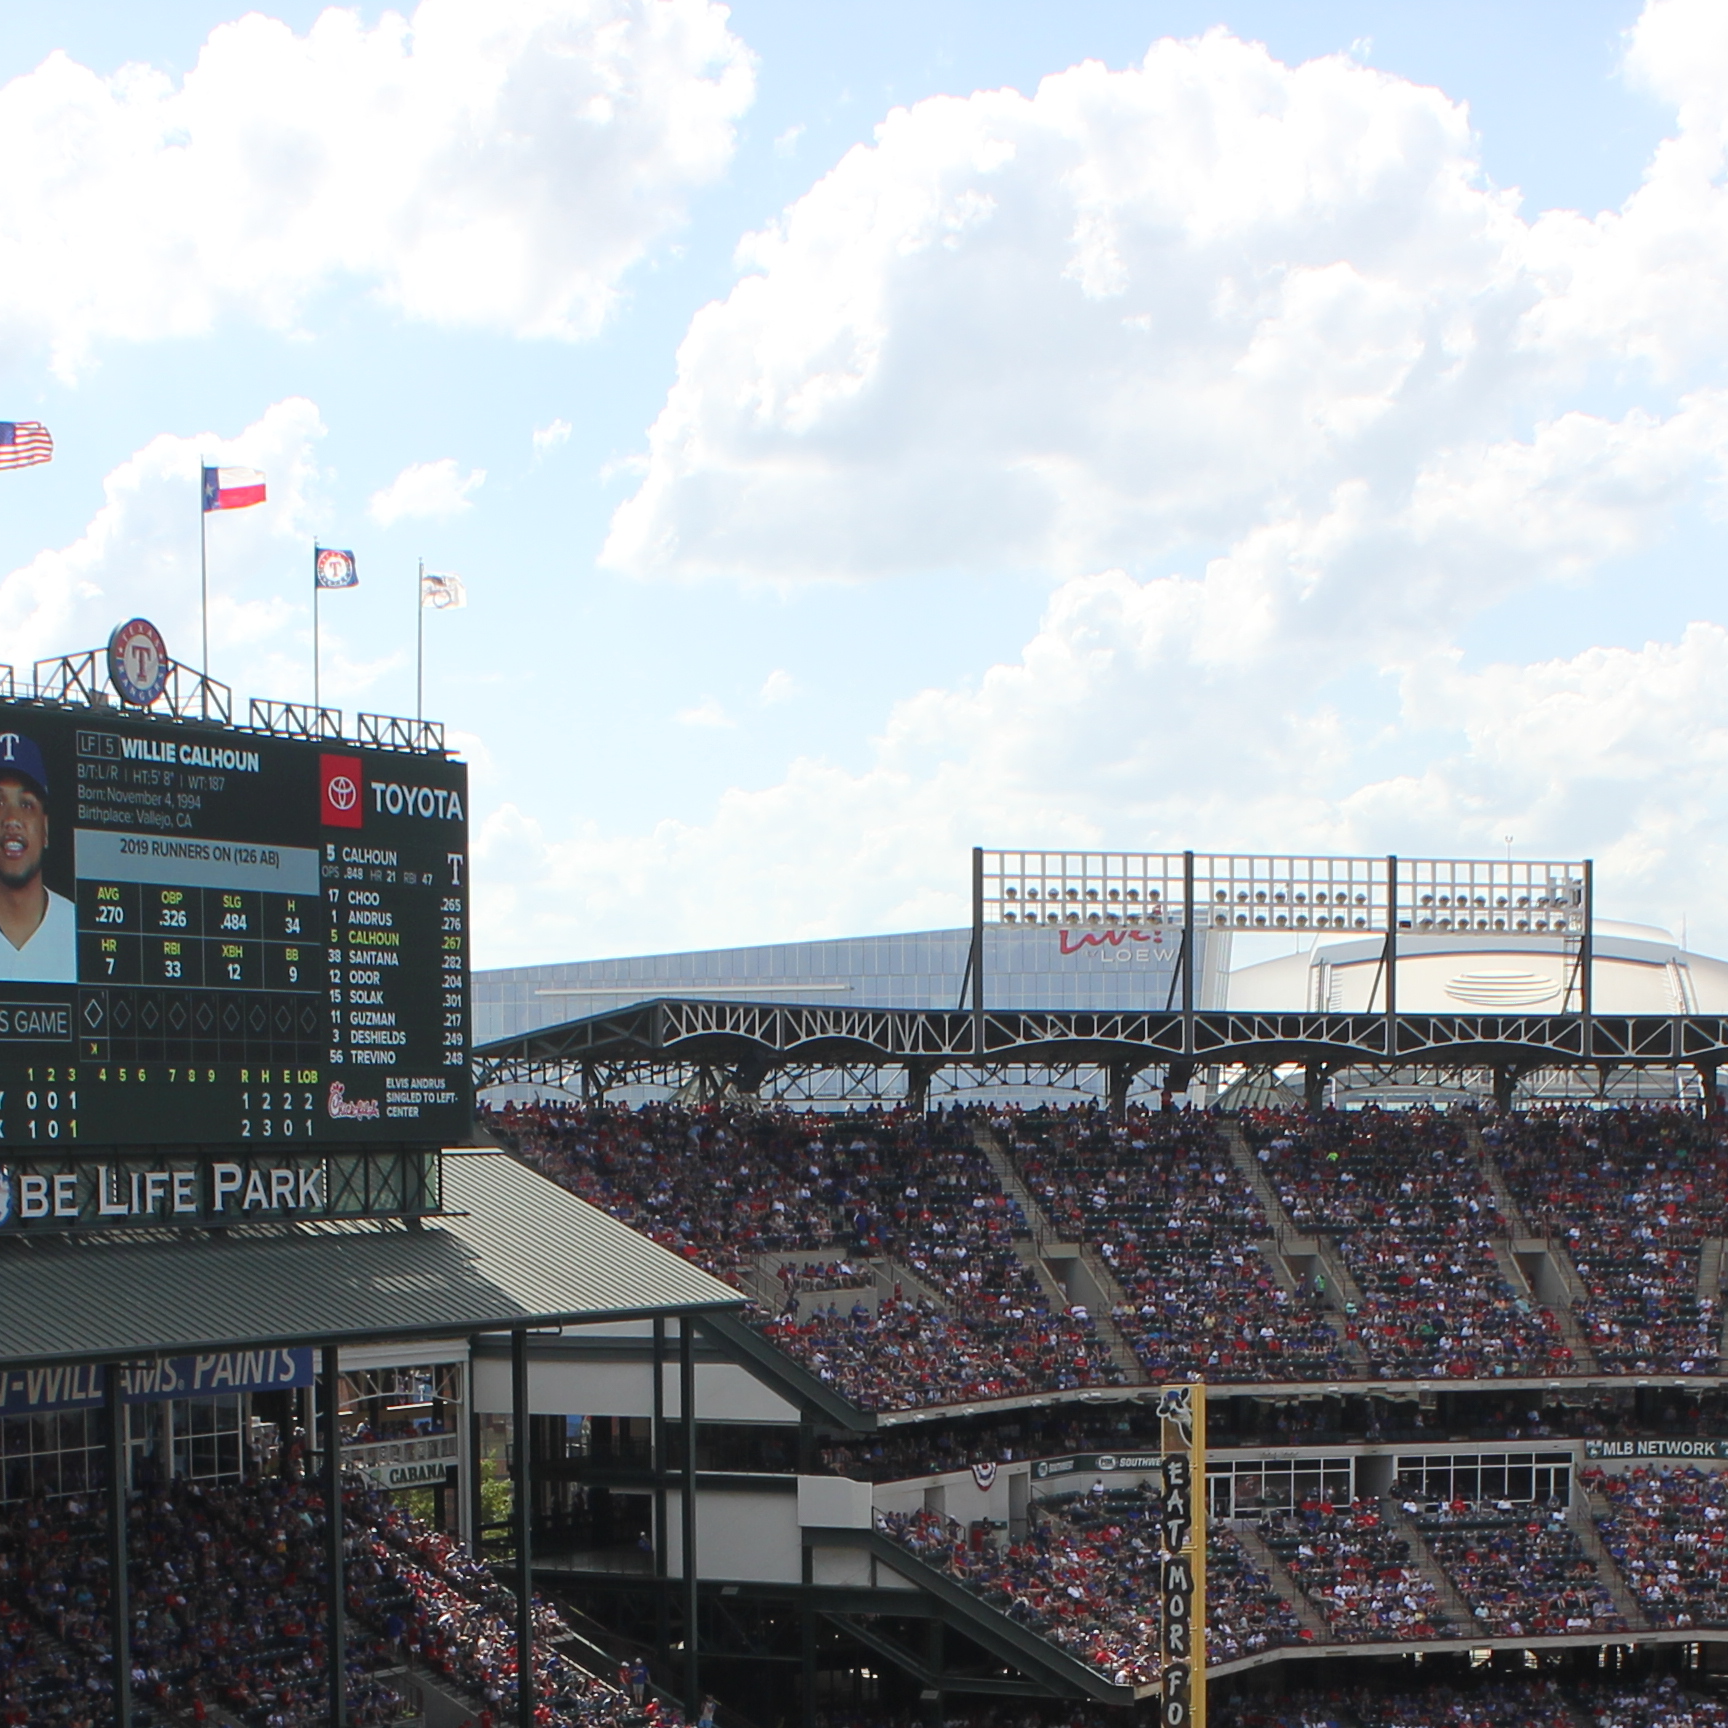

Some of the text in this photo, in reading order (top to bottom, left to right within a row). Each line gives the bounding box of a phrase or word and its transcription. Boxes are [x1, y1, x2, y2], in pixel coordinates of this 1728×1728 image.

[121, 738, 258, 772] WILLIE CALHOUN
[371, 781, 462, 821] TOYOTA
[120, 839, 280, 868] 2019 RUNNERS ON (126 AB)
[326, 844, 396, 865] 5 CALHOUN
[98, 887, 295, 911] AVG OBP SLG H
[348, 891, 379, 906] CHOO
[95, 906, 300, 934] .270 .326 .484 34
[348, 911, 391, 926] ANDRUS
[348, 930, 398, 946] CALHOUN
[349, 951, 398, 966] SANTANA
[1101, 949, 1177, 962] LOEW
[349, 970, 379, 985] ODOR
[350, 991, 382, 1005] SOLAK
[14, 1011, 66, 1034] GAME
[350, 1012, 394, 1026] GUZMAN
[350, 1031, 405, 1045] DESHIELDS
[351, 1050, 395, 1065] TREVINO
[98, 1165, 196, 1217] LIFE
[213, 1162, 324, 1211] PARK
[1603, 1441, 1714, 1455] MLB NETWORK
[1167, 1460, 1185, 1547] EAT
[1168, 1565, 1188, 1652] MOR
